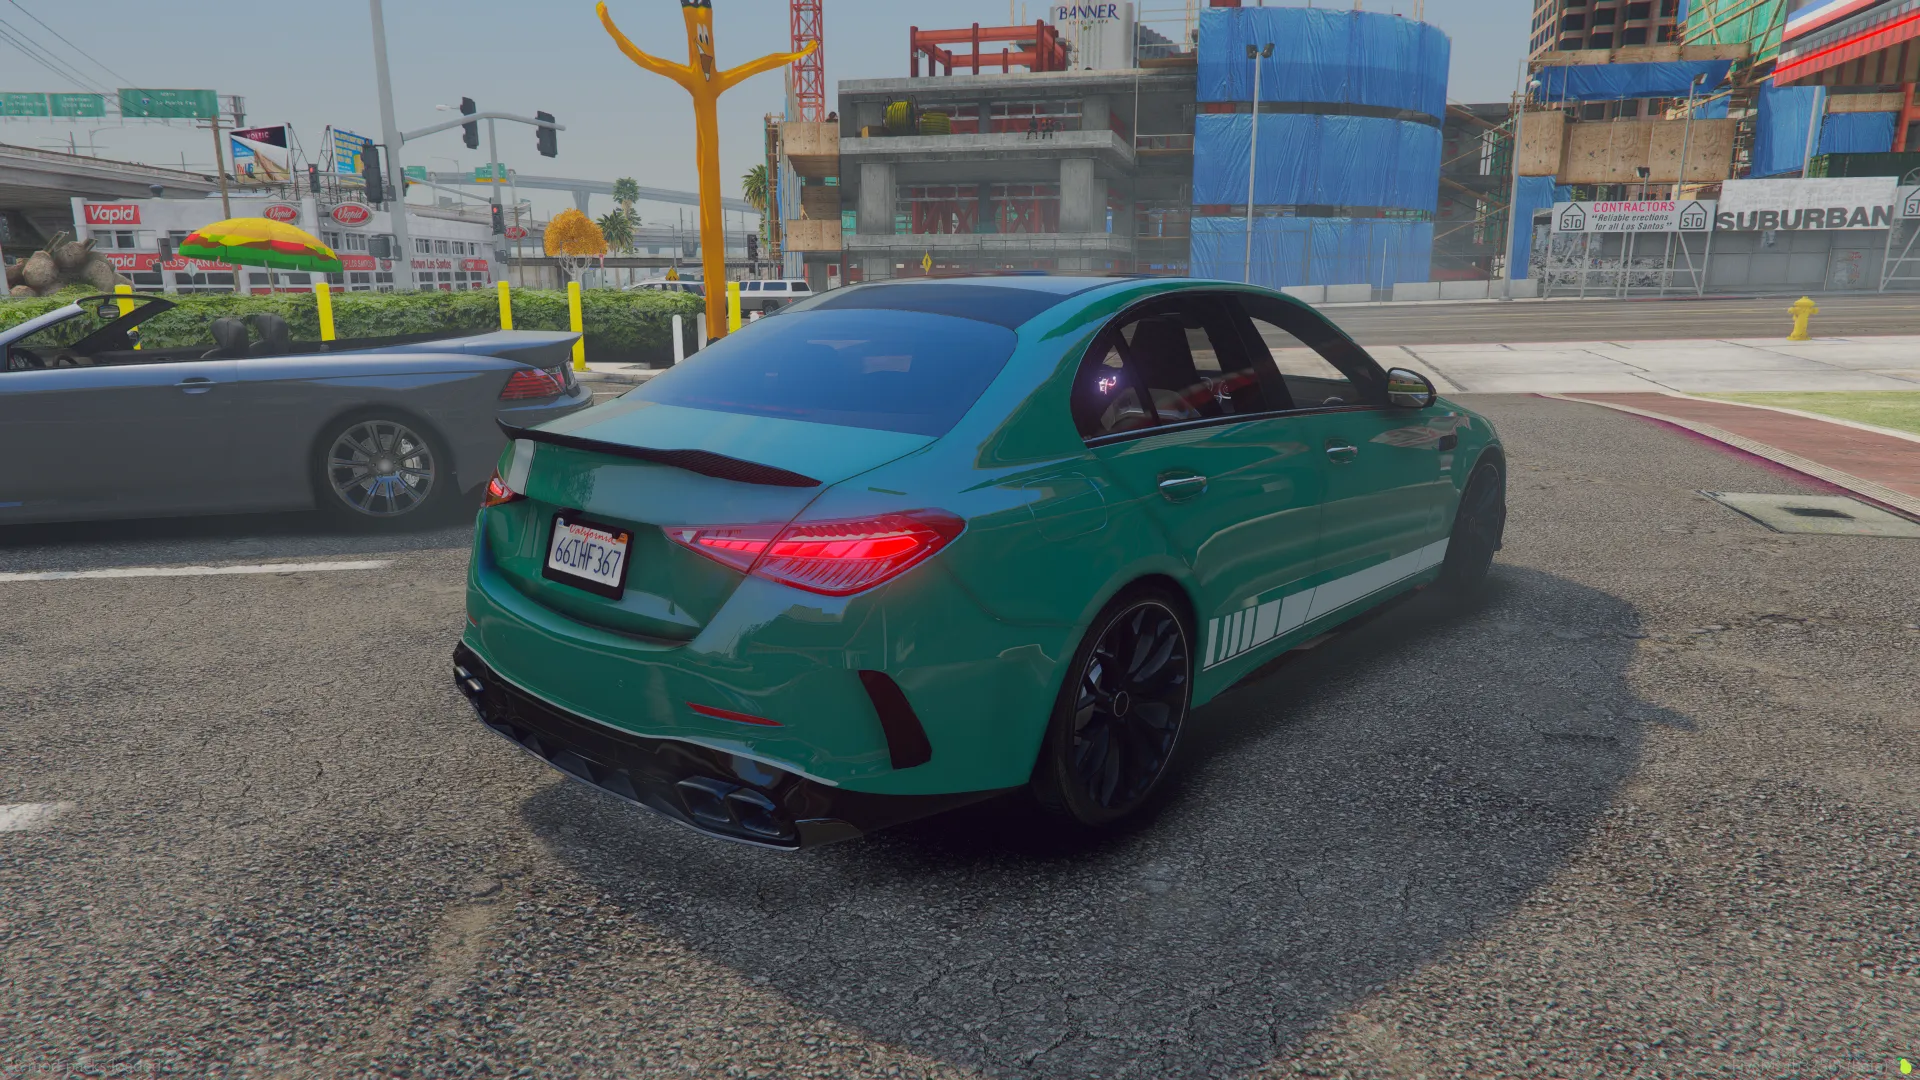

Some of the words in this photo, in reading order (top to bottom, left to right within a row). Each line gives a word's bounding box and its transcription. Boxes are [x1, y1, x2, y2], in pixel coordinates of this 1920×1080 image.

[1056, 3, 1120, 20] BANNER
[246, 131, 269, 140] VOLTIC
[89, 205, 135, 224] Vapid
[269, 207, 293, 220] Vapid
[337, 206, 364, 223] Vapid
[1593, 201, 1675, 213] CONTRACTORS
[1631, 213, 1669, 221] erections
[1716, 205, 1895, 231] SUBURBAN
[1594, 223, 1607, 231] for
[106, 254, 137, 269] apid
[164, 259, 186, 267] LOS
[426, 259, 436, 269] Los
[436, 259, 452, 269] Santos
[569, 523, 616, 546] California
[555, 537, 622, 578] 66IHF367
